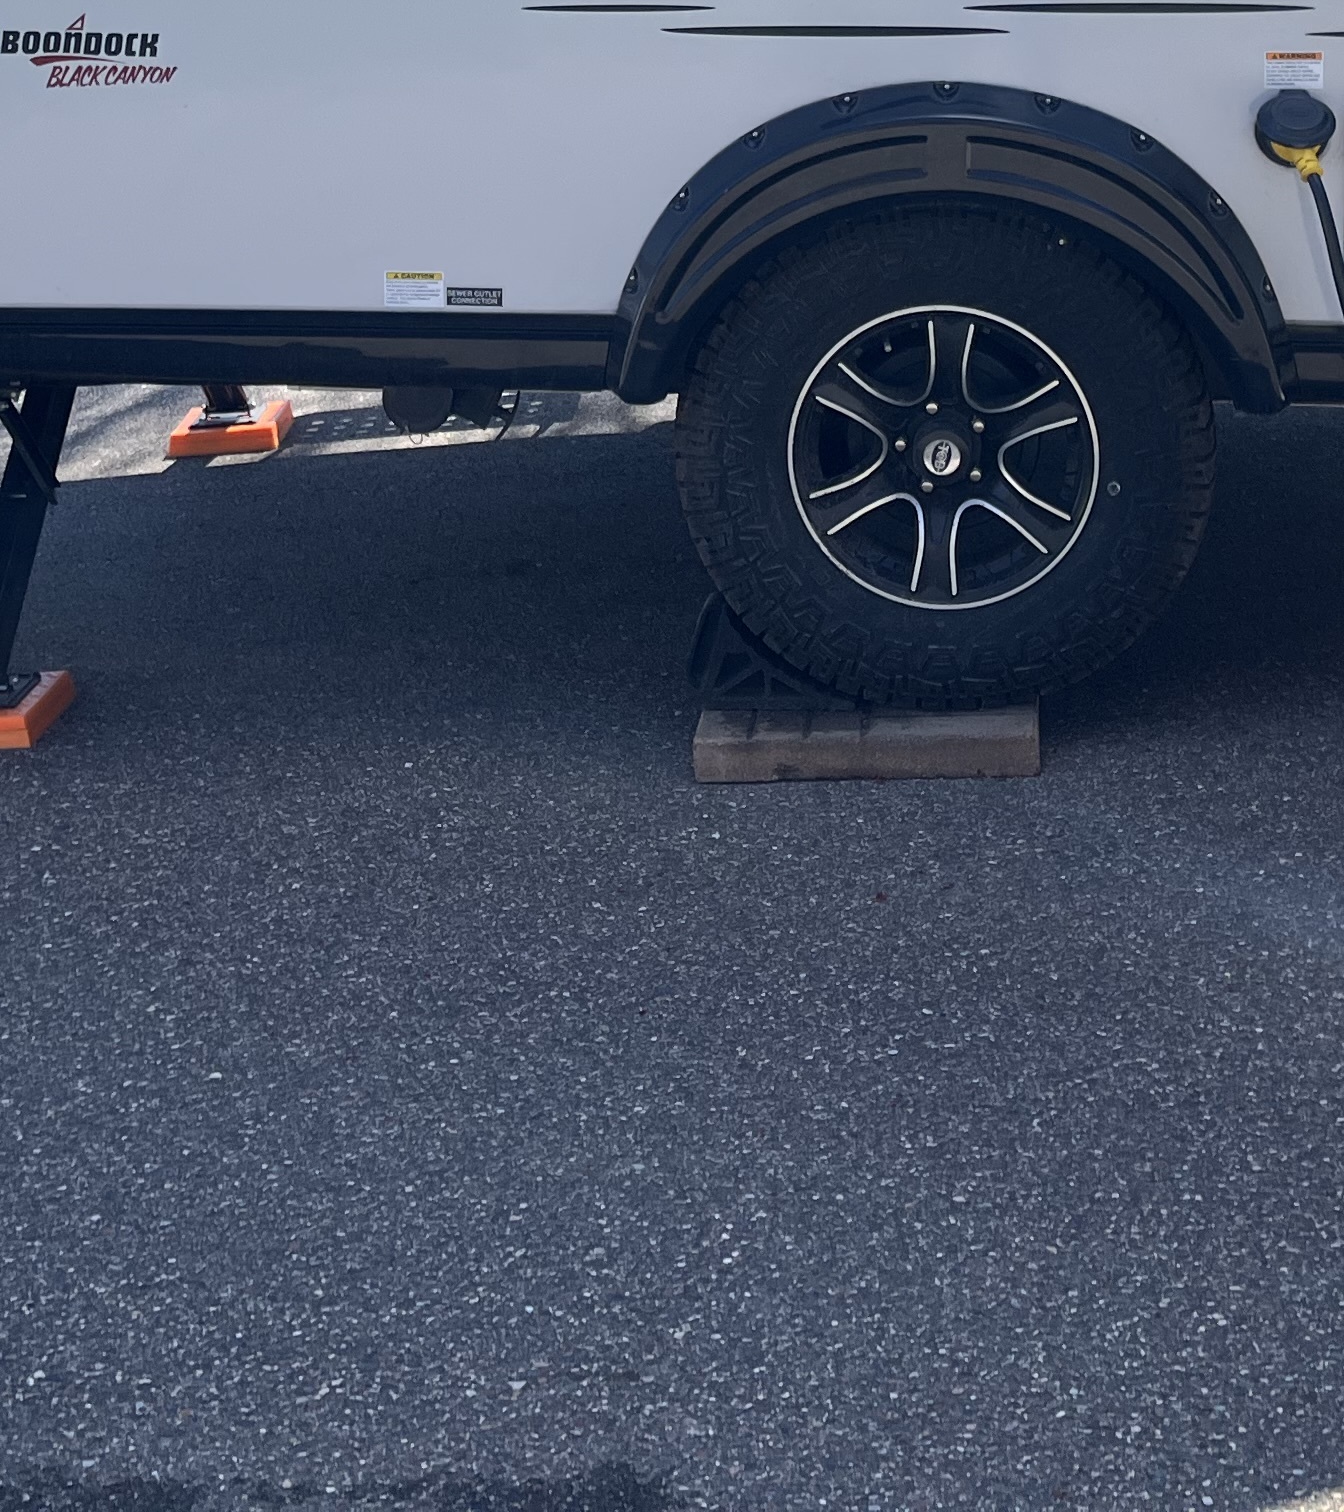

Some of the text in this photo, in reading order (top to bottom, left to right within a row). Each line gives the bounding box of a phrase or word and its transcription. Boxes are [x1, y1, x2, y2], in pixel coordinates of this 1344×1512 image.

[0, 30, 160, 58] BOONDOCK
[1278, 52, 1316, 60] WARNING
[46, 64, 178, 88] BLACK CANYON
[401, 272, 435, 280] CAUTION
[447, 289, 502, 298] SEWER OUTLET
[451, 297, 498, 305] CONNECTION
